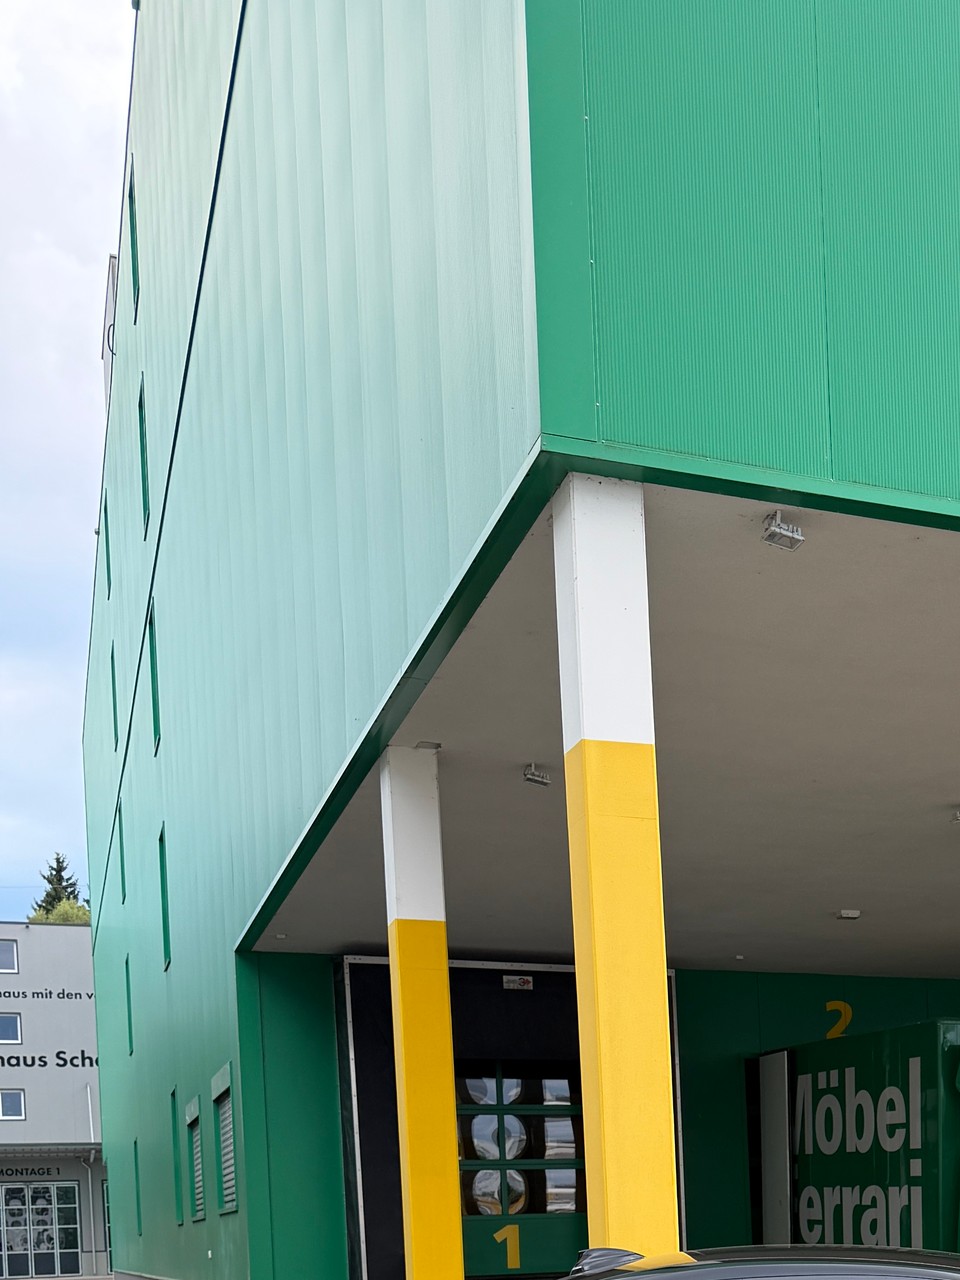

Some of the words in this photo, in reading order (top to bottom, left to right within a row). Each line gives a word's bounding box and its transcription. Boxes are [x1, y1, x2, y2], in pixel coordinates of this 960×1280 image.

[32, 988, 53, 999] mit
[57, 988, 82, 1000] den
[86, 992, 96, 1000] v
[825, 1000, 853, 1040] 2
[55, 1050, 99, 1068] Sch
[56, 1167, 60, 1175] 1
[796, 1158, 923, 1250] errari
[493, 1224, 521, 1270] 1
